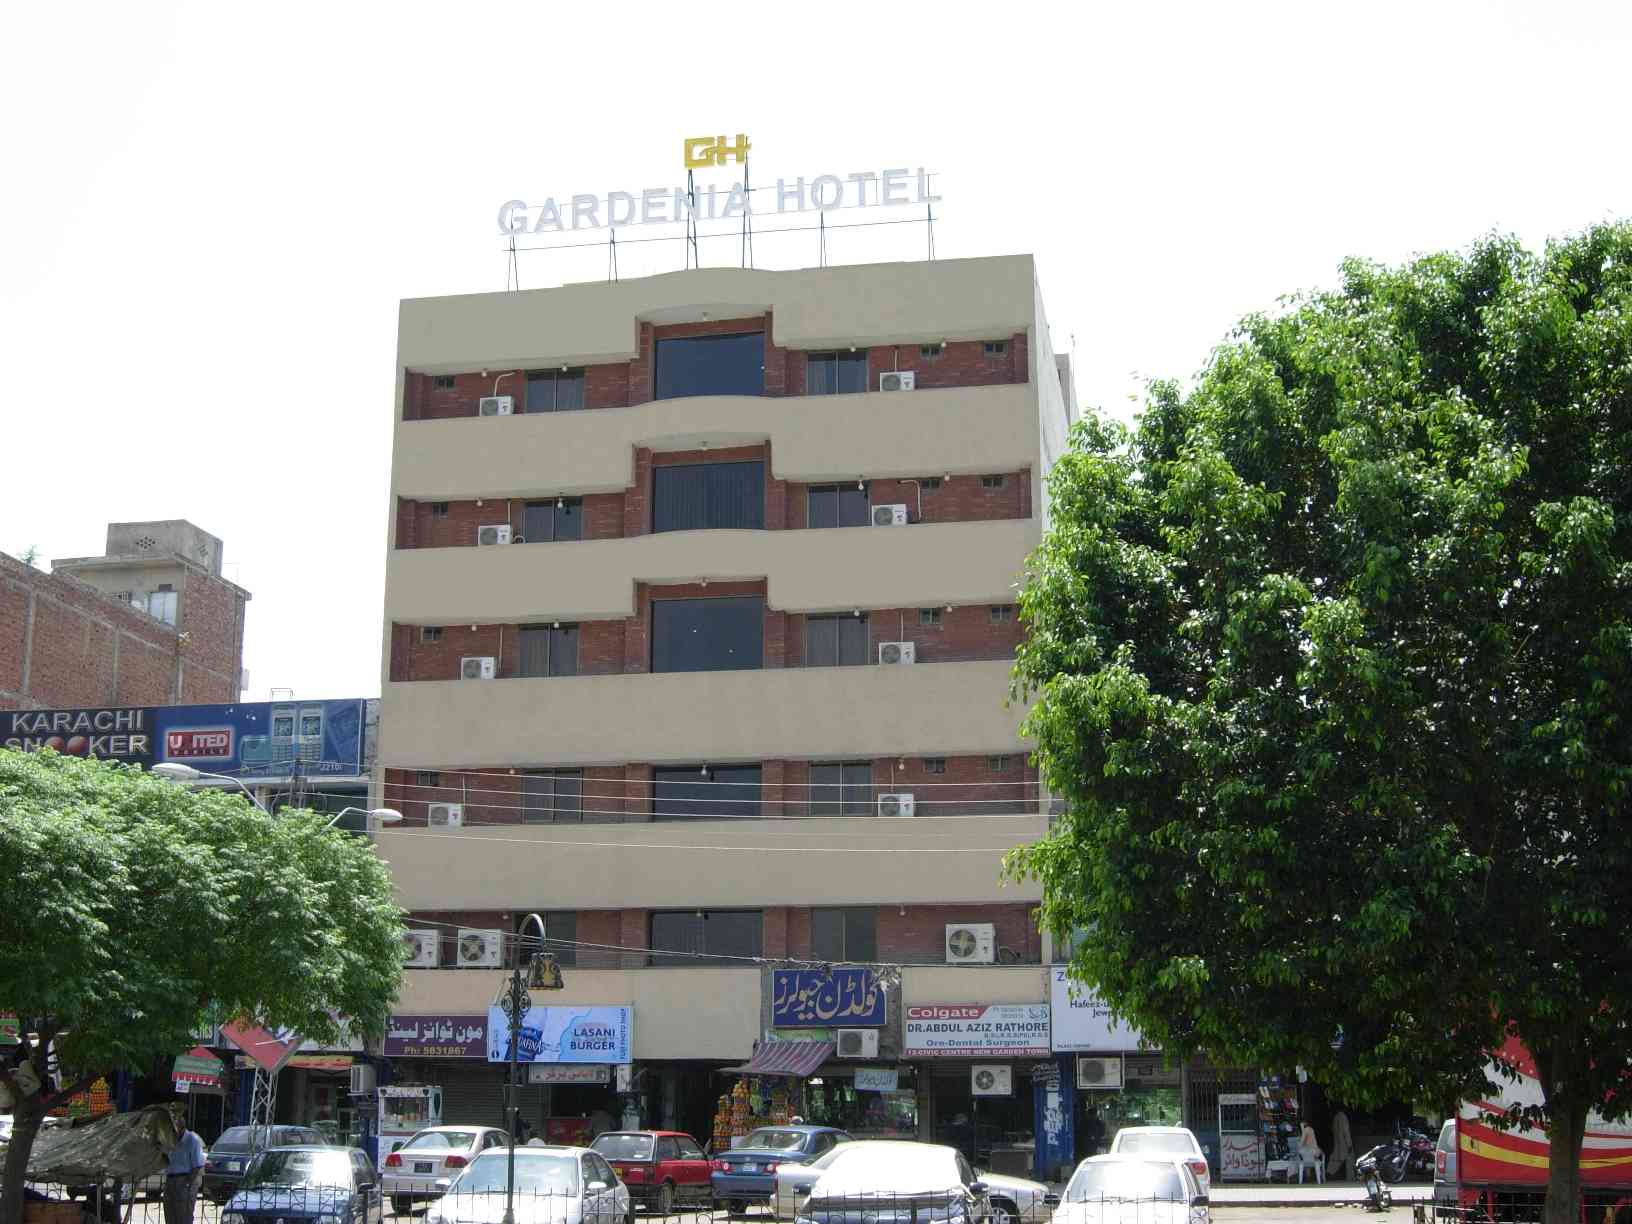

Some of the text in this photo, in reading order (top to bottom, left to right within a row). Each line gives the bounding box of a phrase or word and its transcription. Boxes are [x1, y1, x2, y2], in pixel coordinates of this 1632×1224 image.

[684, 133, 752, 169] GH
[497, 166, 942, 235] GARDENIA HOTEL
[12, 709, 144, 733] KARACHI
[169, 735, 227, 750] UITED
[907, 1006, 980, 1019] Colgate
[574, 1029, 616, 1037] LASANI
[907, 1022, 1049, 1033] DR.ABDUL AZIZ RATHORE
[570, 1041, 616, 1050] BURGER
[986, 1039, 1030, 1047] Surgeon
